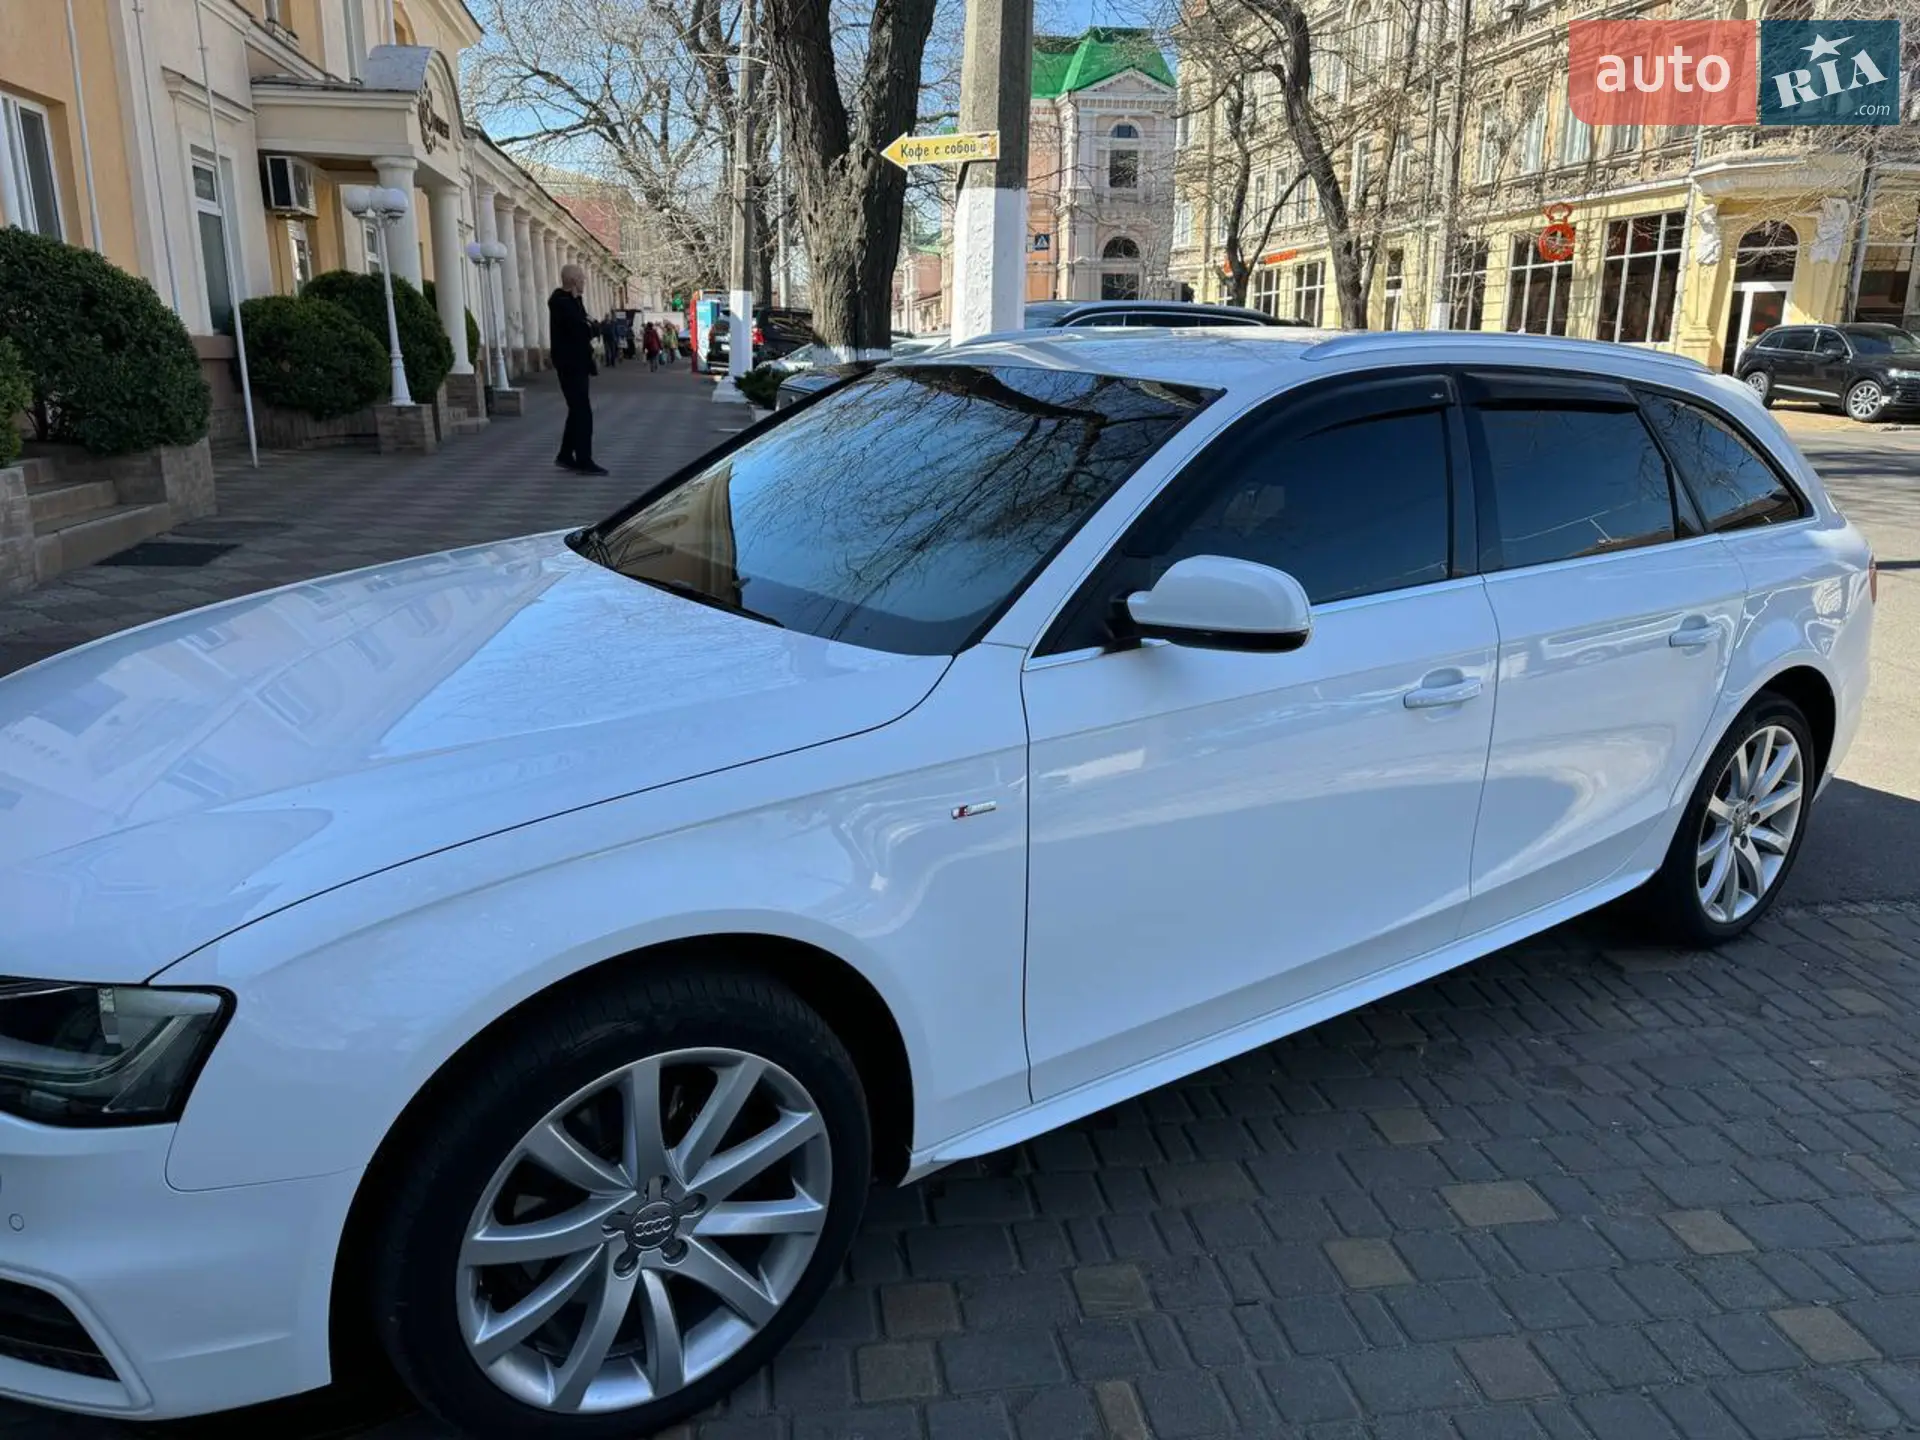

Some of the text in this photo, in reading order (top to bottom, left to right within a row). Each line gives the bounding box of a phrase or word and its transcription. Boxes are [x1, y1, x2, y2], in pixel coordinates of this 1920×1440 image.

[900, 140, 977, 160] Кофе с собой
